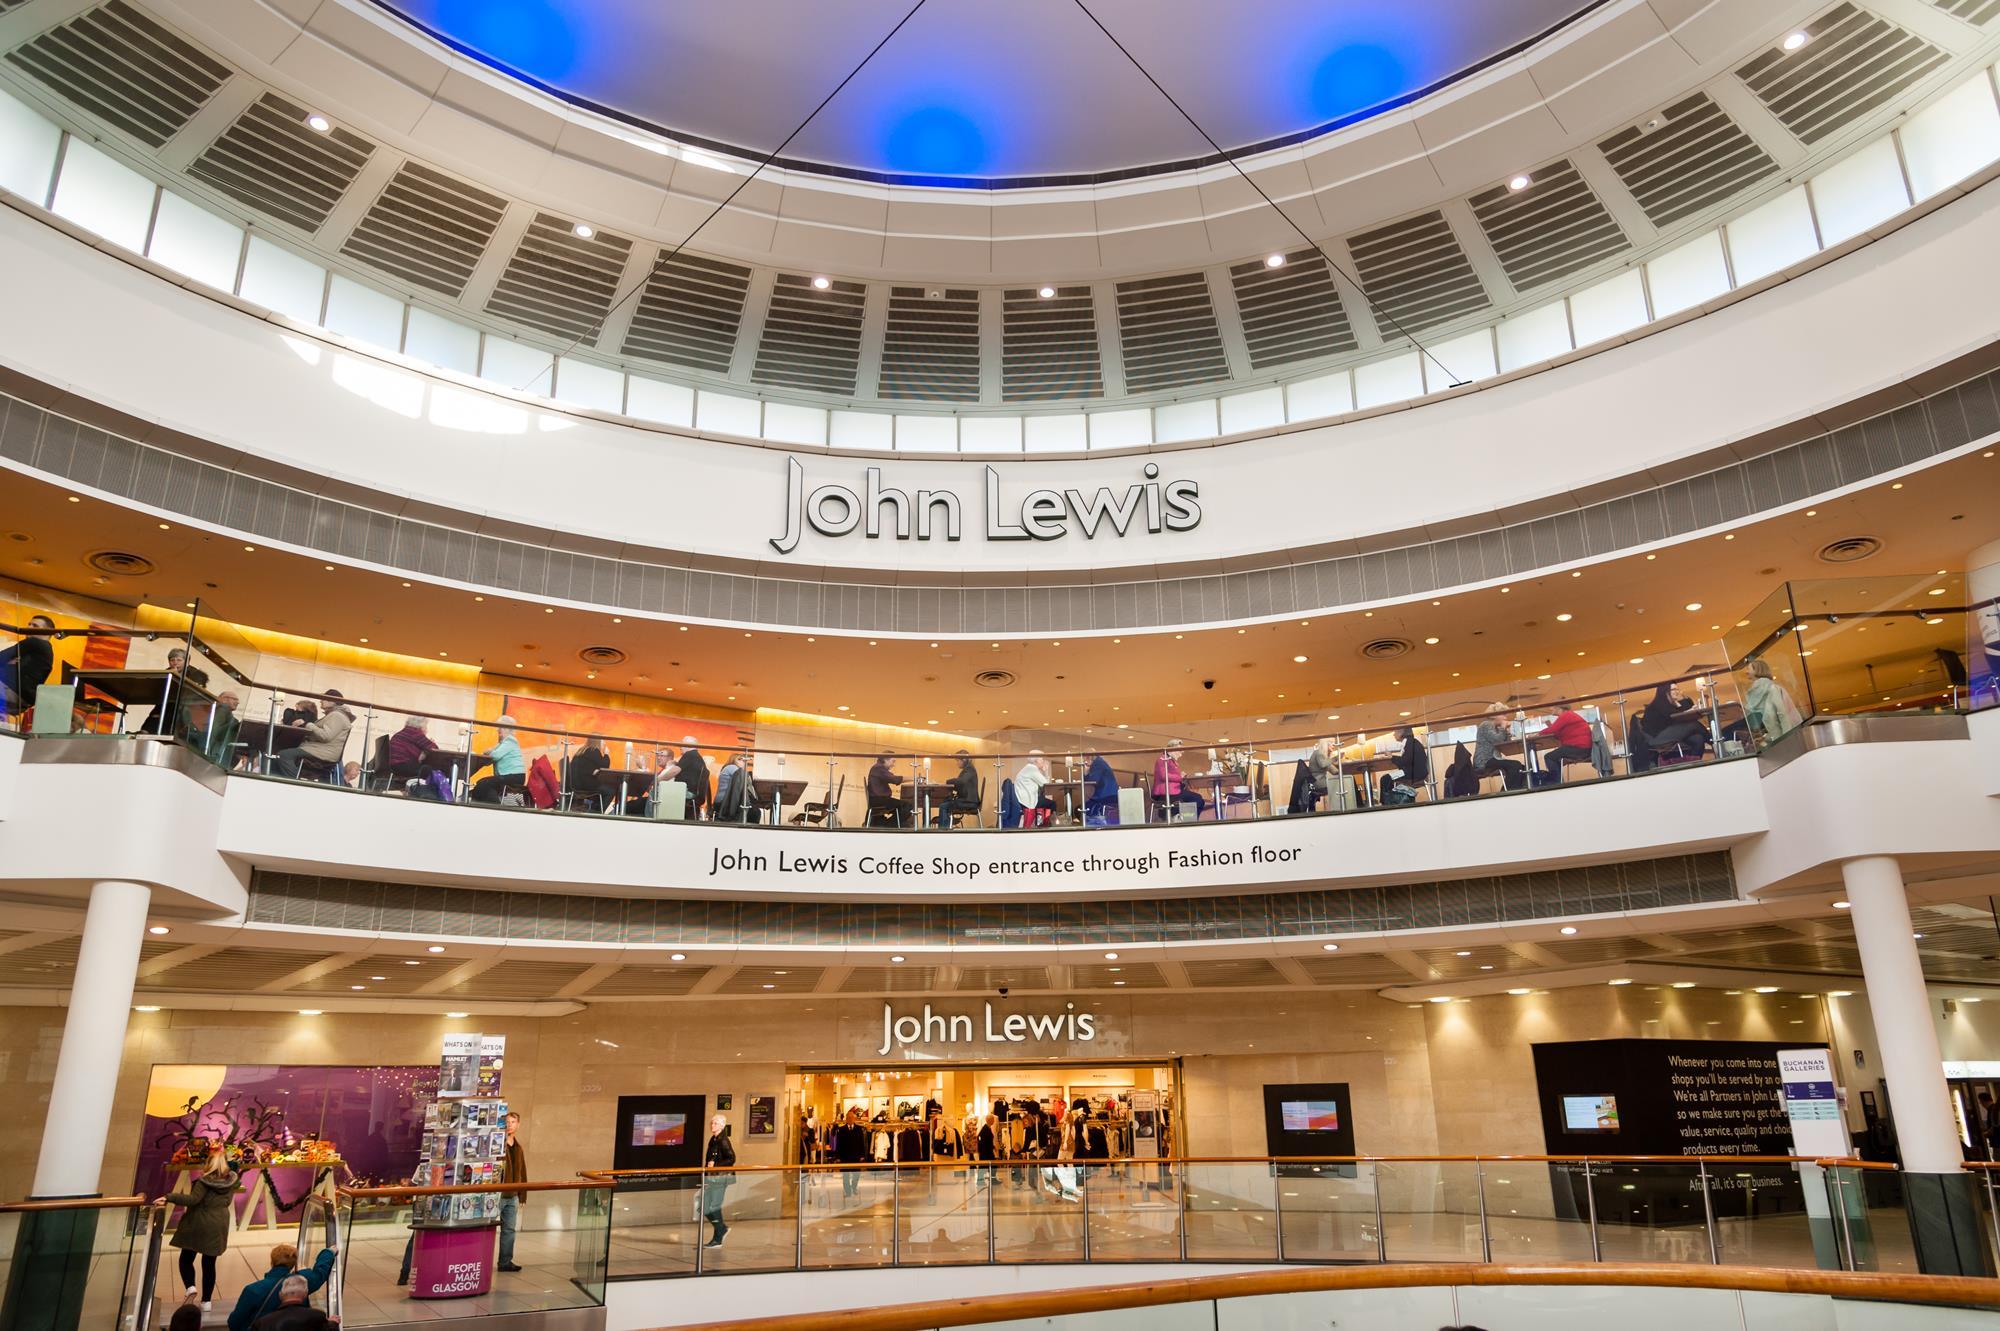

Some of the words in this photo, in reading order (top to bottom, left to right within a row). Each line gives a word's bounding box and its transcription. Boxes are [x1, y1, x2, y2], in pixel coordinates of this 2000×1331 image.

[769, 455, 961, 554] John
[986, 462, 1202, 541] Lewis
[709, 847, 767, 875] John
[779, 850, 848, 873] Lewis
[858, 857, 924, 874] Coffee
[932, 857, 981, 879] Shop
[988, 859, 1075, 874] entrance
[1082, 854, 1160, 875] through
[1168, 848, 1243, 868] Fashion
[1250, 845, 1302, 863] floor
[878, 1001, 973, 1056] John
[985, 1001, 1096, 1041] Lewis
[1668, 1055, 1708, 1068] Whenever
[1711, 1059, 1725, 1071] you
[1726, 1059, 1746, 1068] come
[1747, 1058, 1762, 1068] into
[1764, 1060, 1777, 1069] one
[1671, 1073, 1694, 1087] shops
[1695, 1073, 1716, 1087] you'll
[1717, 1073, 1728, 1085] be
[1728, 1074, 1754, 1085] served
[1755, 1074, 1763, 1087] by
[1765, 1076, 1774, 1085] an
[1673, 1090, 1698, 1102] We're
[1699, 1089, 1708, 1101] all
[1709, 1090, 1742, 1101] Partners
[1743, 1090, 1751, 1101] in
[1752, 1090, 1768, 1104] John
[1677, 1110, 1687, 1119] so
[1689, 1110, 1701, 1119] we
[1702, 1107, 1721, 1119] make
[1724, 1109, 1741, 1119] sure
[1743, 1109, 1756, 1121] you
[1757, 1109, 1769, 1121] get
[1770, 1107, 1781, 1118] the
[1680, 1125, 1704, 1138] value,
[1704, 1125, 1734, 1137] service,
[1734, 1124, 1758, 1139] quality
[1760, 1123, 1773, 1135] and
[1774, 1123, 1793, 1135] choic
[1682, 1142, 1718, 1156] products
[1720, 1144, 1740, 1155] every
[1741, 1142, 1761, 1153] time.
[1711, 1178, 1724, 1190] all,
[1724, 1177, 1735, 1189] it's
[1736, 1178, 1750, 1188] our
[1751, 1175, 1784, 1187] business.
[448, 1262, 482, 1274] PEOPLE
[455, 1271, 480, 1283] MAKE
[432, 1282, 480, 1293] GLASGOW
